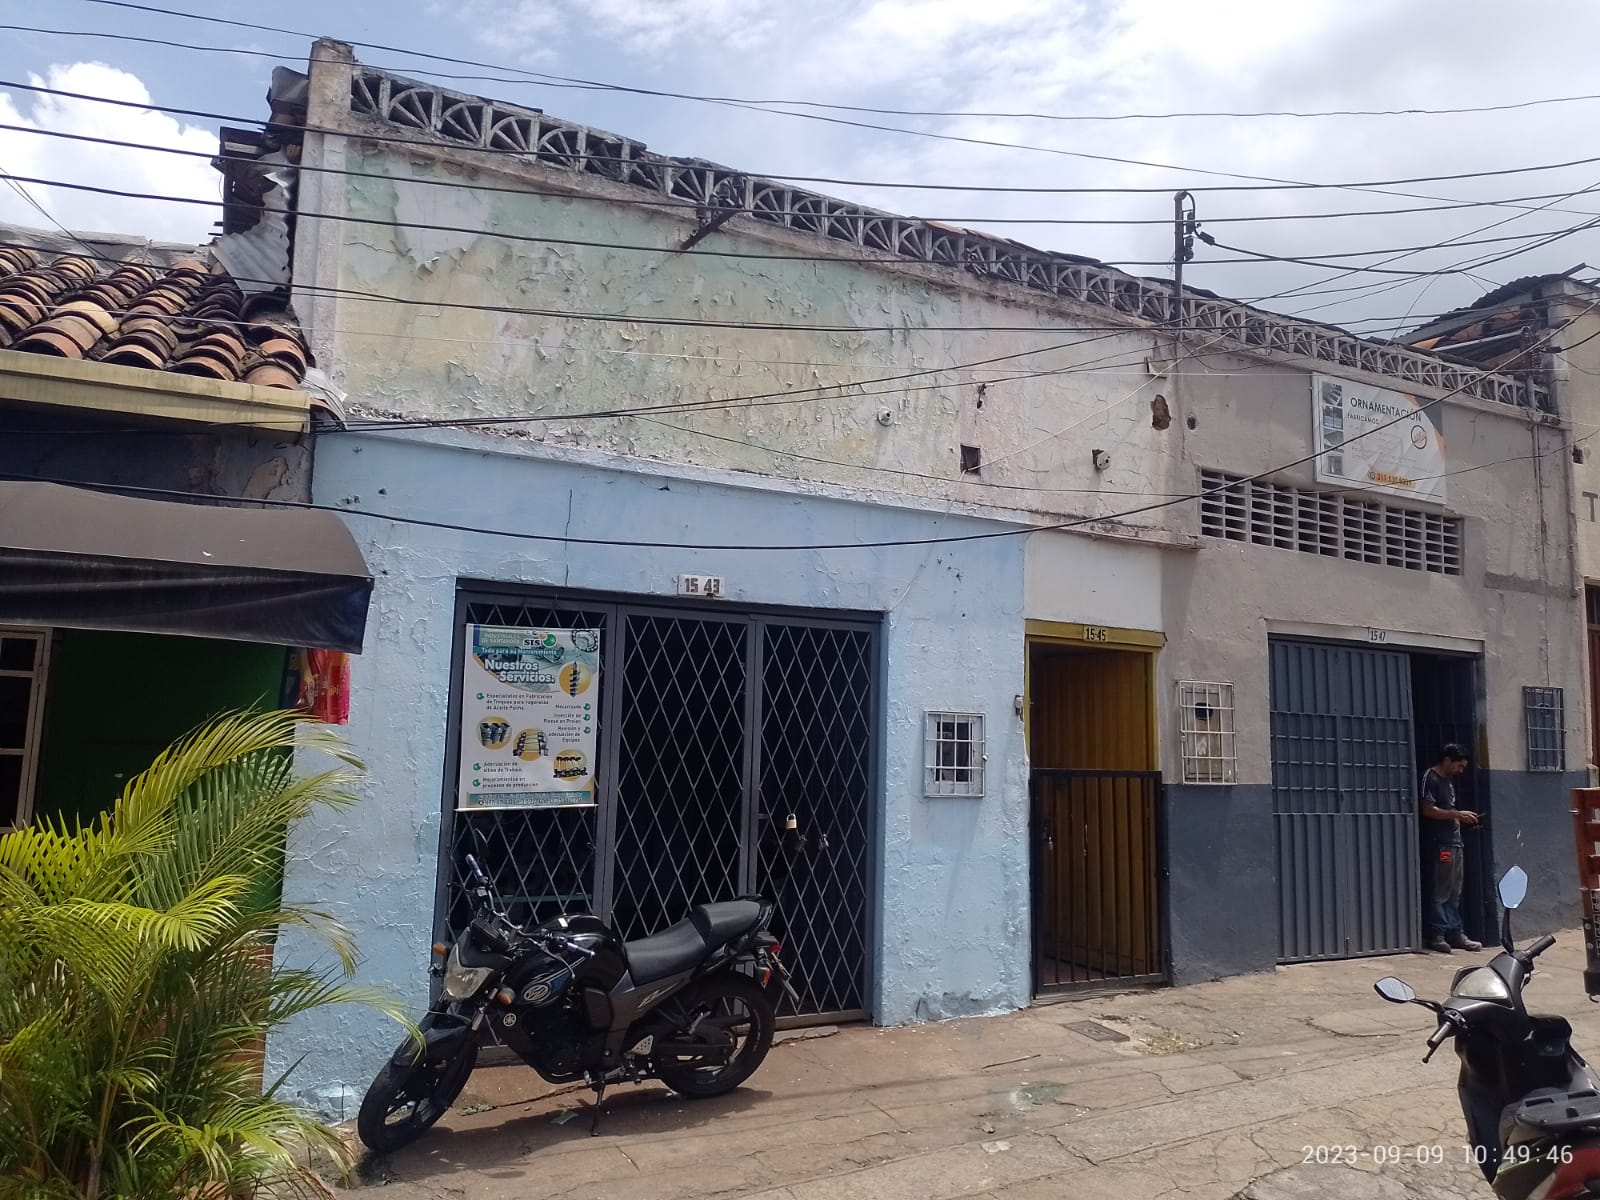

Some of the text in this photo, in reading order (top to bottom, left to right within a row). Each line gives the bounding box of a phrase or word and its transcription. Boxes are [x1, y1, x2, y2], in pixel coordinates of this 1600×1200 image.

[1350, 397, 1421, 422] ORNAMENTACIÓN
[484, 659, 538, 671] Nuestros
[499, 671, 555, 682] Servicios.
